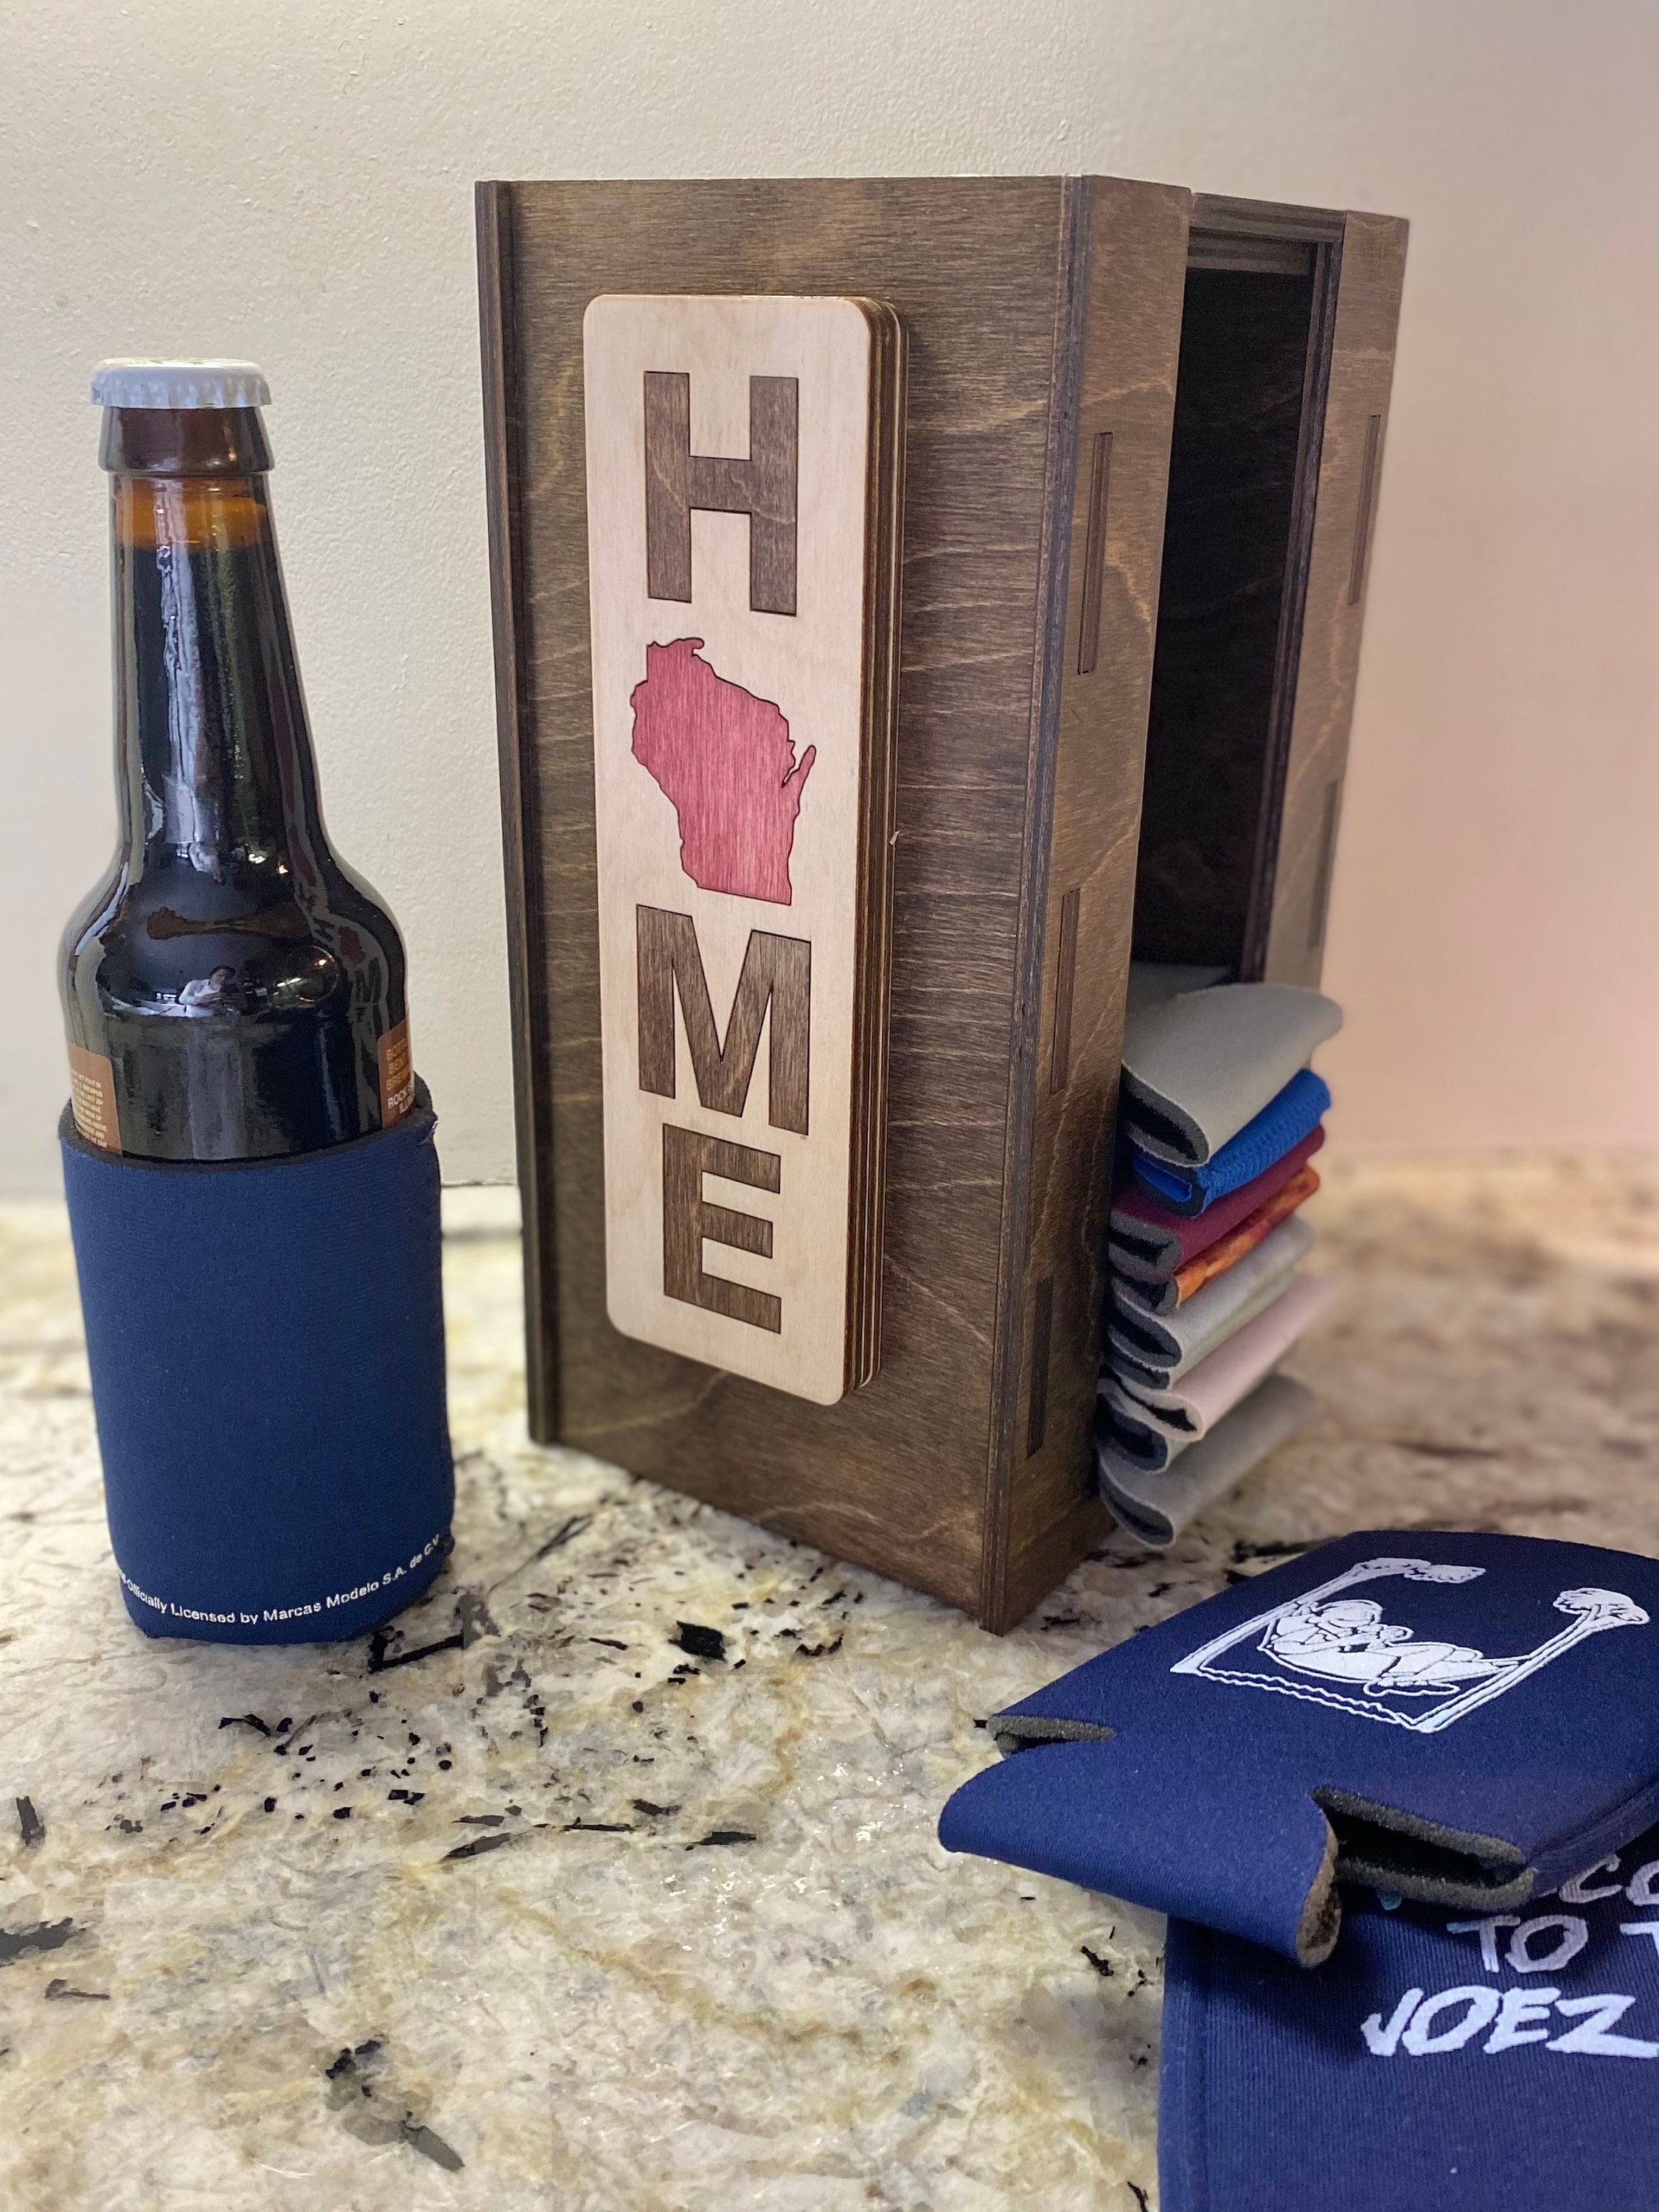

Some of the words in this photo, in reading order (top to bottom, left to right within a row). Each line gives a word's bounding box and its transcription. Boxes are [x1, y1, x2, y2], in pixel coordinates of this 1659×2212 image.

[127, 1579, 167, 1614] Officially
[170, 1603, 235, 1624] Licensed
[240, 1612, 258, 1624] by
[263, 1601, 322, 1621] Marcas
[326, 1580, 380, 1610] Modelo
[1447, 1914, 1590, 1973] TO
